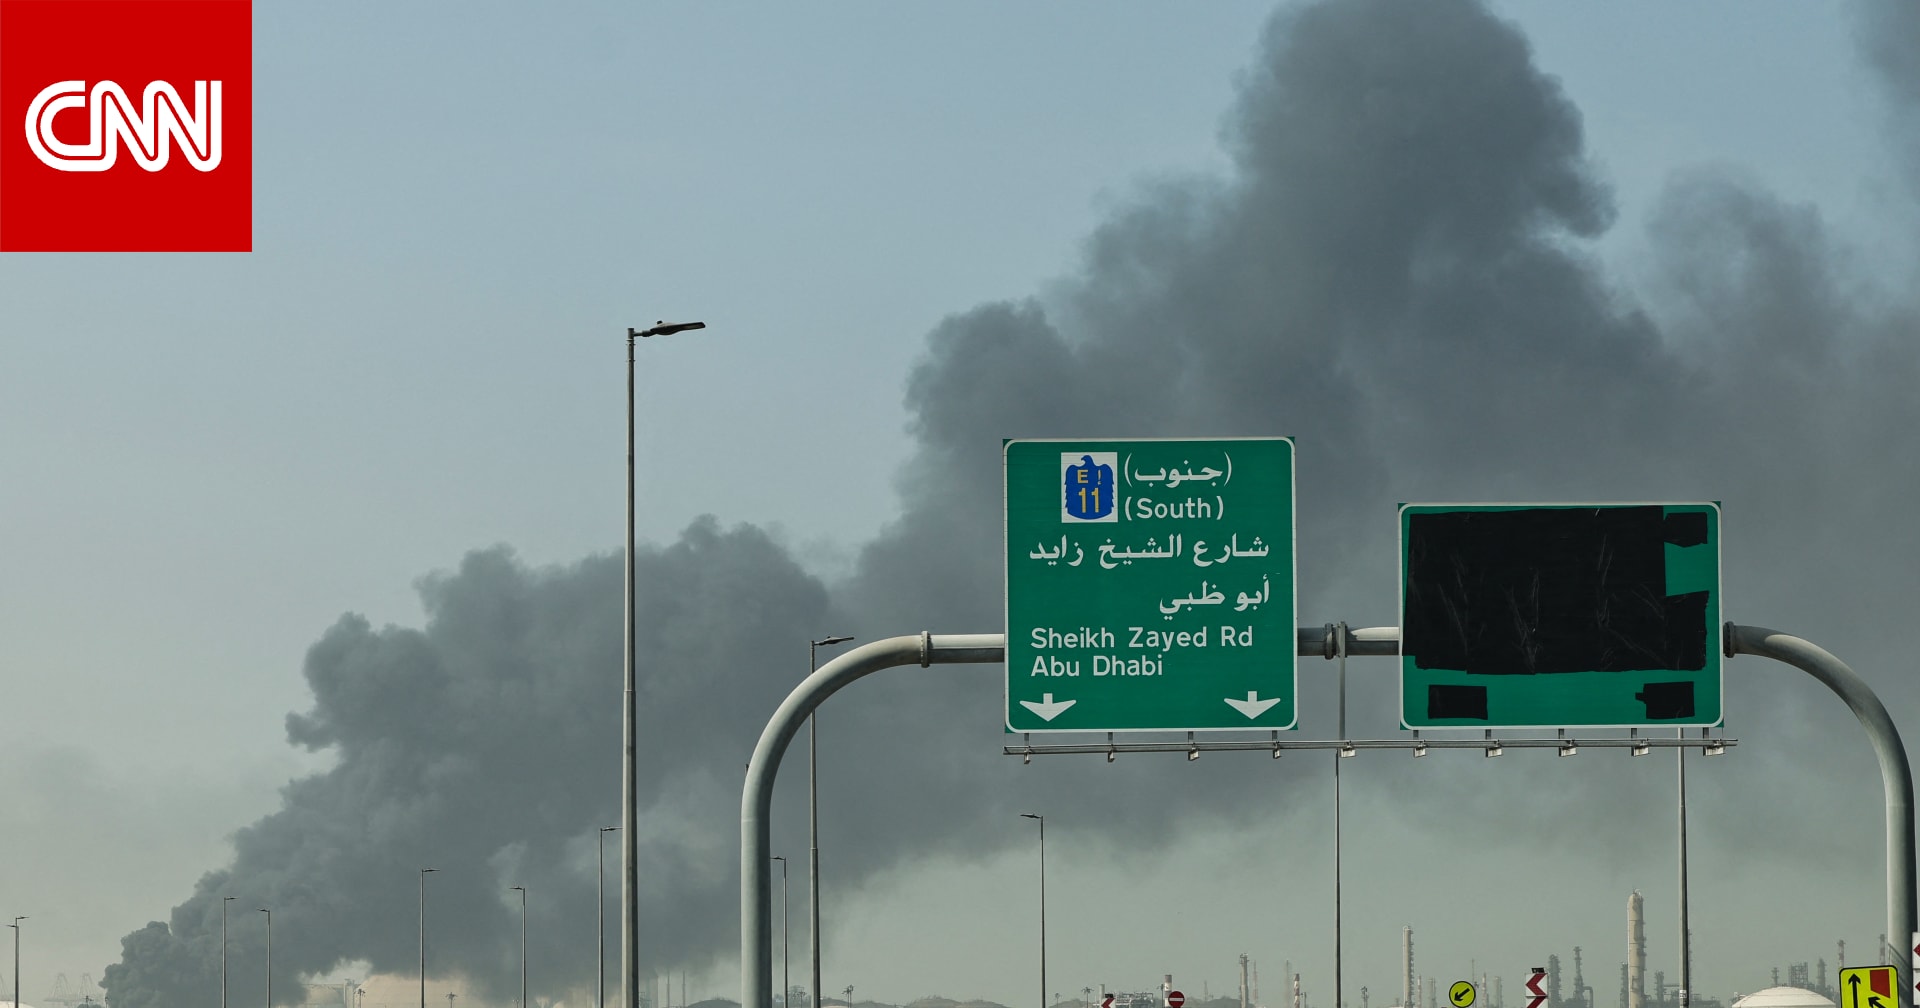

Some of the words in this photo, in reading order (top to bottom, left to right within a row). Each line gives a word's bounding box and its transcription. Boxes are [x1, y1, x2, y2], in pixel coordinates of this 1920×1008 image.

[1078, 469, 1089, 484] E
[1125, 452, 1231, 487] (جنوب)
[1078, 487, 1100, 513] 11
[1125, 496, 1224, 520] (South)
[1030, 534, 1084, 566] زايد
[1098, 533, 1182, 569] الشيخ
[1193, 533, 1269, 567] شارع
[1159, 581, 1225, 620] ظبي
[1234, 574, 1270, 612] أبو
[1030, 627, 1115, 649] Sheikh
[1128, 626, 1207, 652] Zayed
[1221, 626, 1253, 647] Rd
[1031, 655, 1080, 677] Abu
[1093, 654, 1164, 677] Dhabi
